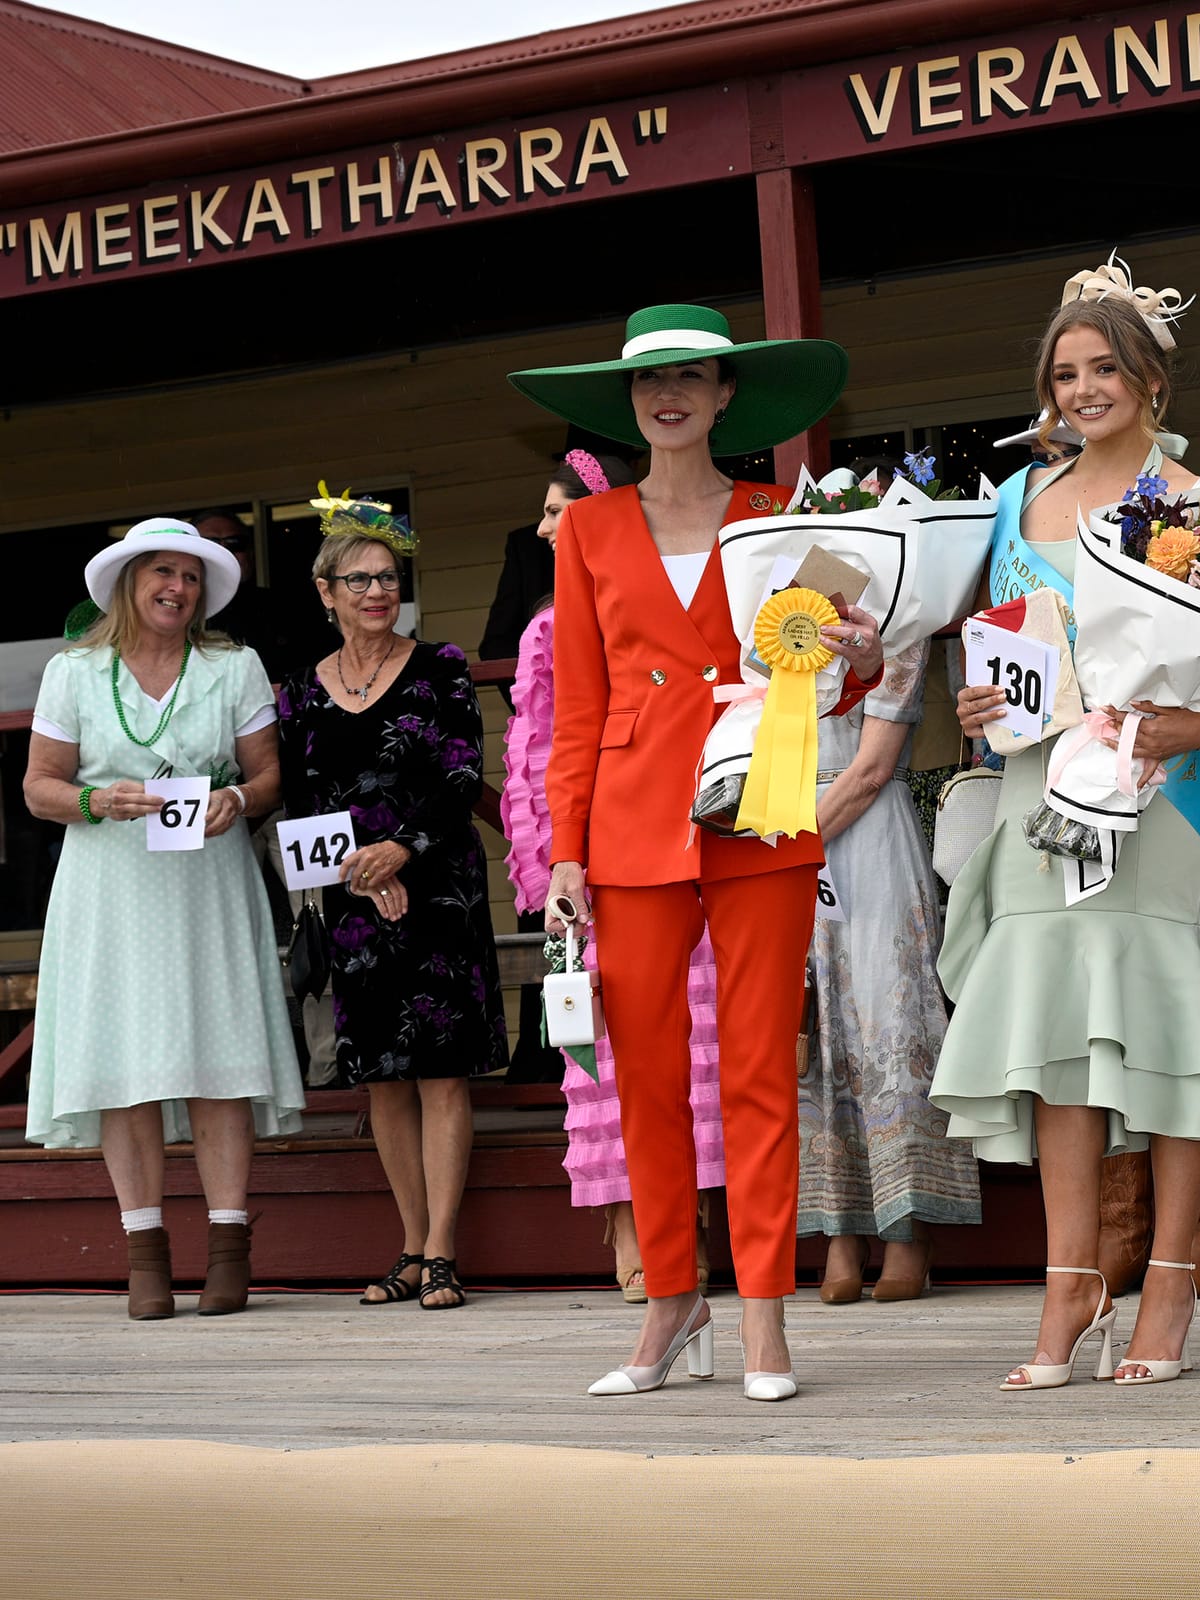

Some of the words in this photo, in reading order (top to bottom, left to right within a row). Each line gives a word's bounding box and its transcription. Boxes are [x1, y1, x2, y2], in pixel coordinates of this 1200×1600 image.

[986, 655, 1042, 715] 130
[159, 798, 201, 829] 67
[286, 832, 350, 872] 142
